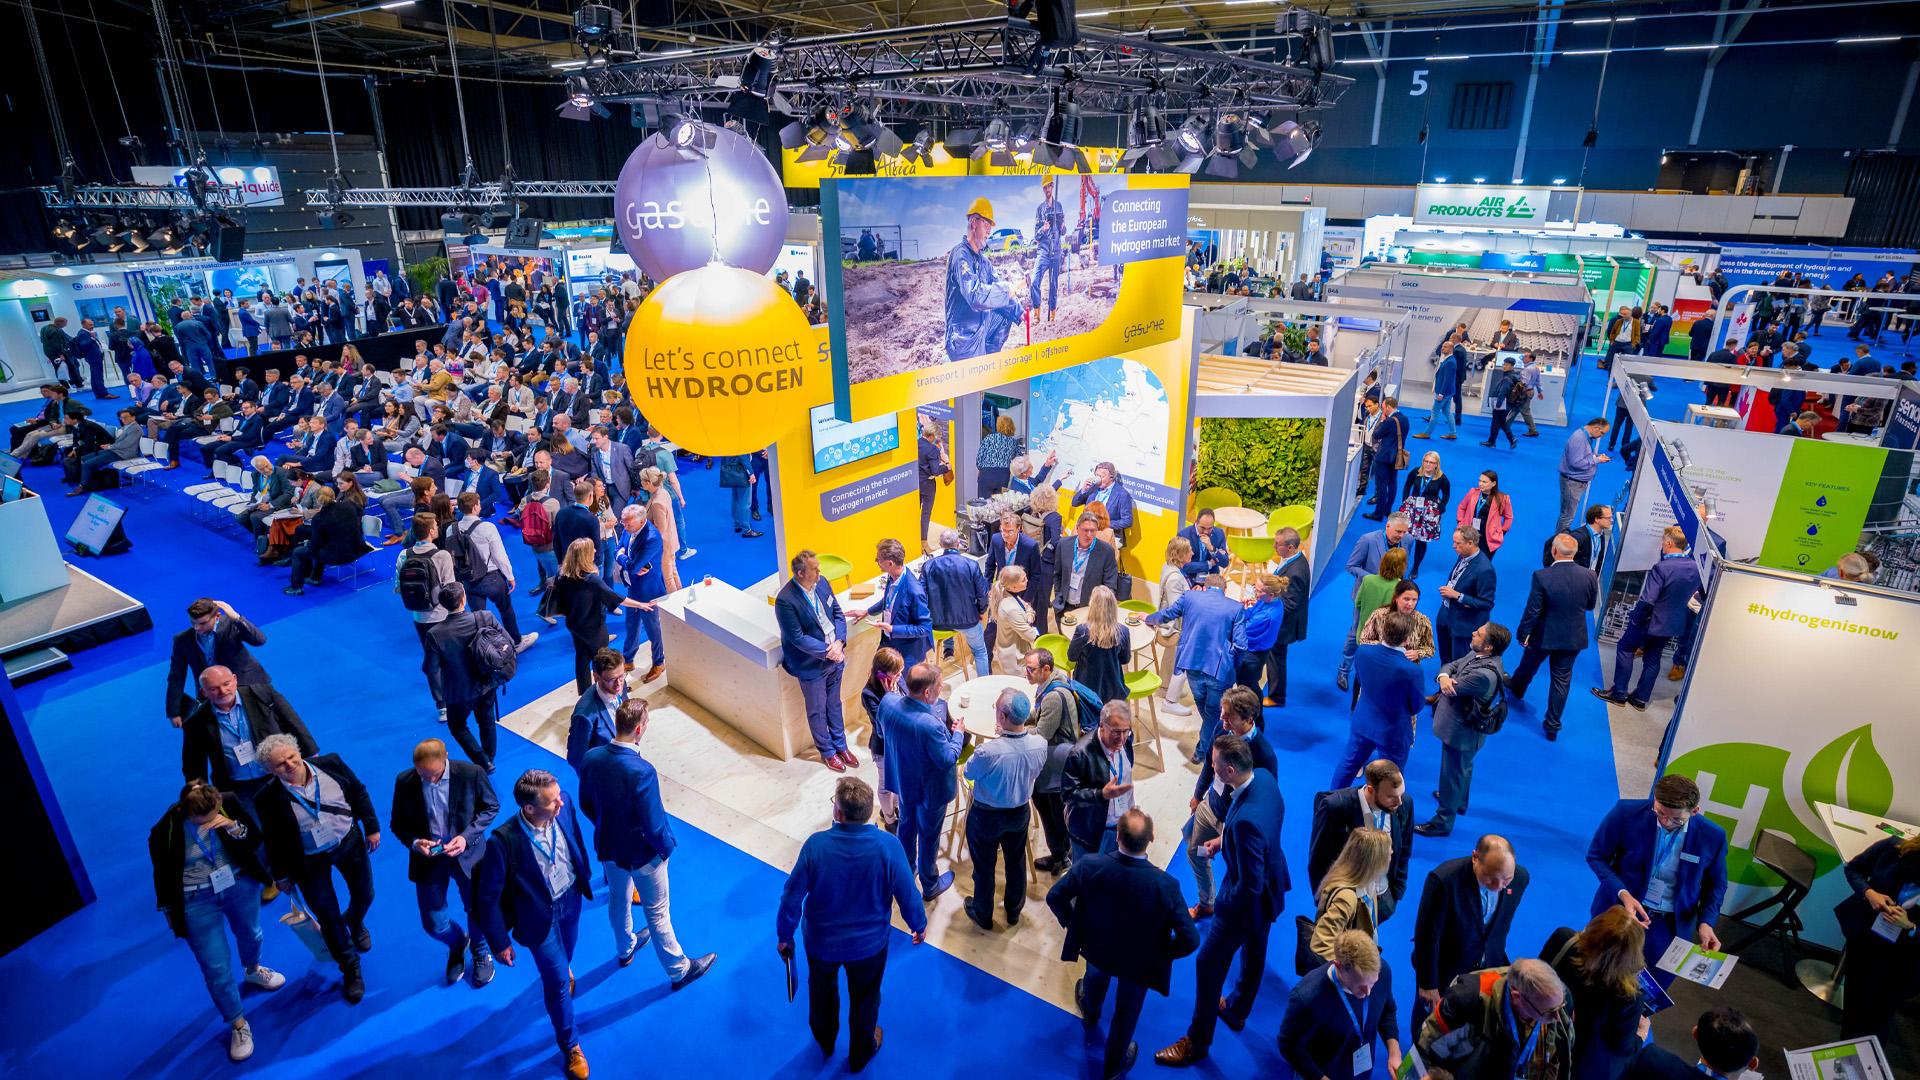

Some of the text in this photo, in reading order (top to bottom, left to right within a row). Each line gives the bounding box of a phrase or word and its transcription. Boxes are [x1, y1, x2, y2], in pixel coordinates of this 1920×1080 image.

[1410, 70, 1429, 96] 5
[1112, 198, 1161, 214] Connecting
[1428, 205, 1503, 217] PRODUCTS
[1478, 196, 1505, 207] AIR
[1111, 219, 1167, 233] the European
[1110, 235, 1180, 256] hydrogen market
[1803, 263, 1836, 272] hydrogen
[644, 347, 695, 371] Let's
[703, 340, 803, 370] connect
[916, 344, 1069, 388] transport import storage offshore
[646, 366, 803, 399] HYDROGEN
[831, 469, 913, 503] Connecting the European
[1145, 483, 1156, 491] the
[831, 488, 889, 515] hydrogen market
[1133, 489, 1175, 505] infrastructure
[1747, 602, 1899, 641] #hydrogenisnow
